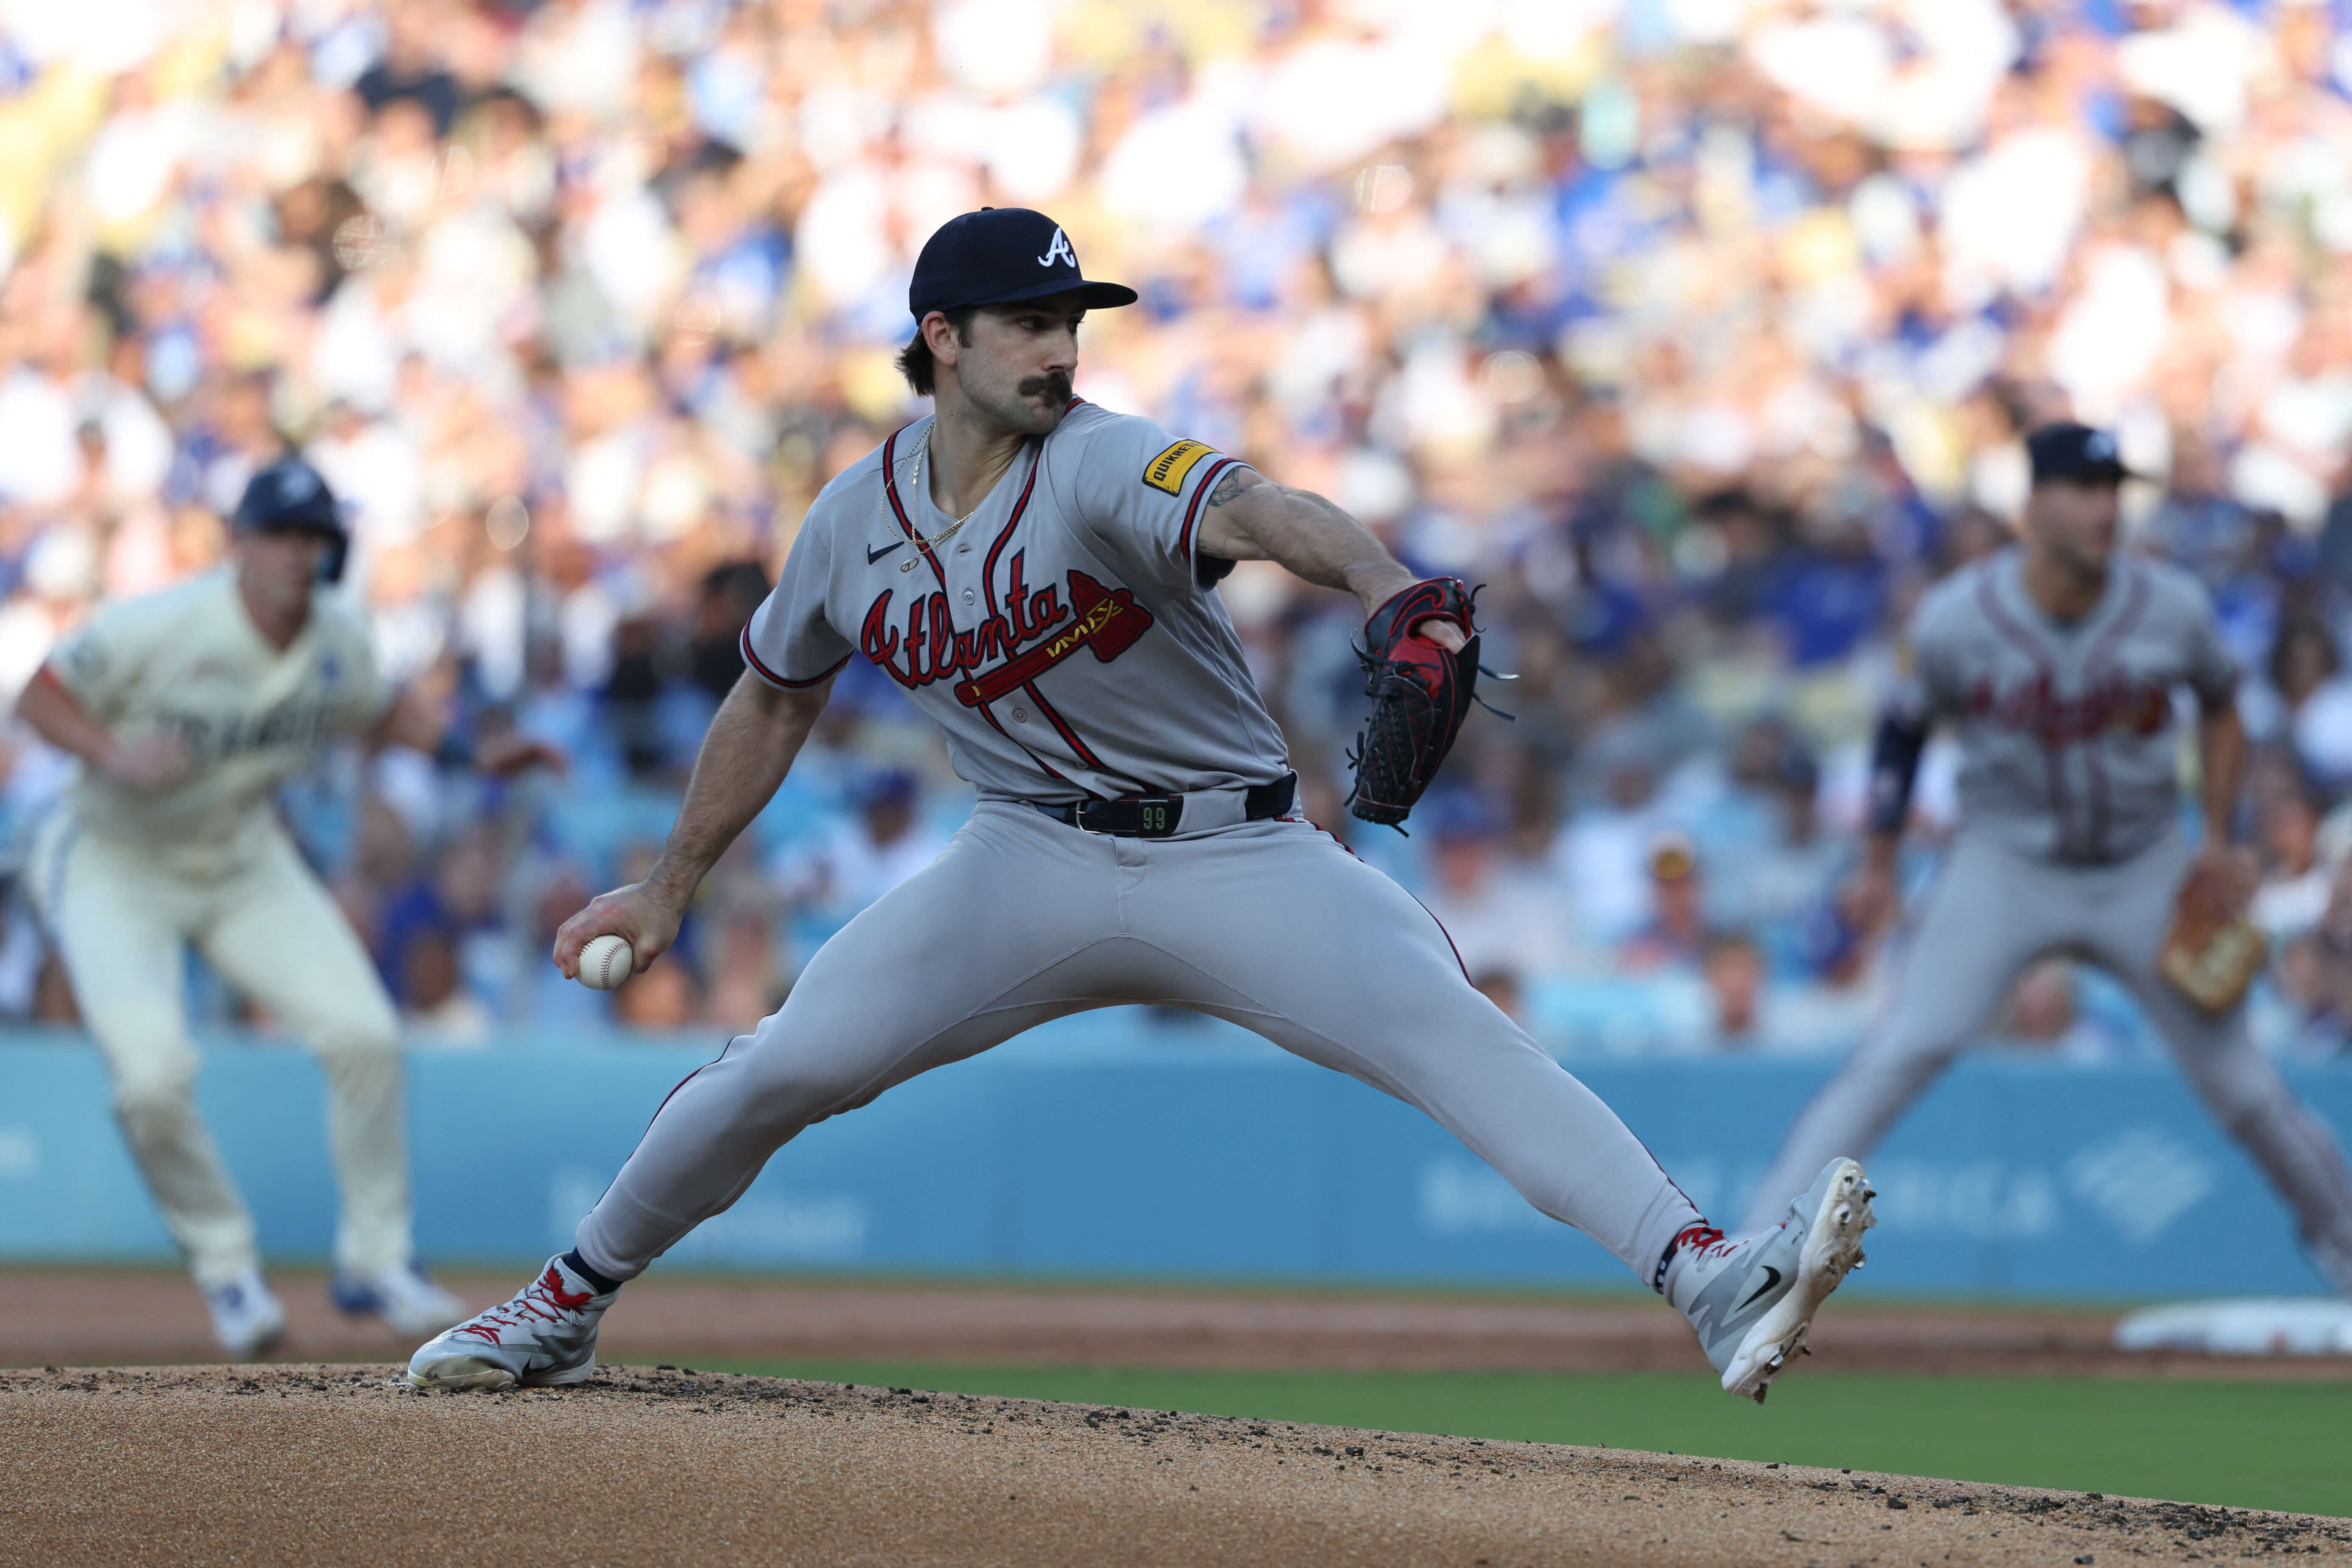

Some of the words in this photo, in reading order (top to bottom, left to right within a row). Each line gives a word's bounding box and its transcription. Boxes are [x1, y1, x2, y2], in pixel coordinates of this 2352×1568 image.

[1038, 227, 1076, 268] A
[860, 547, 1069, 690] Atlanta
[1143, 807, 1165, 830] 99
